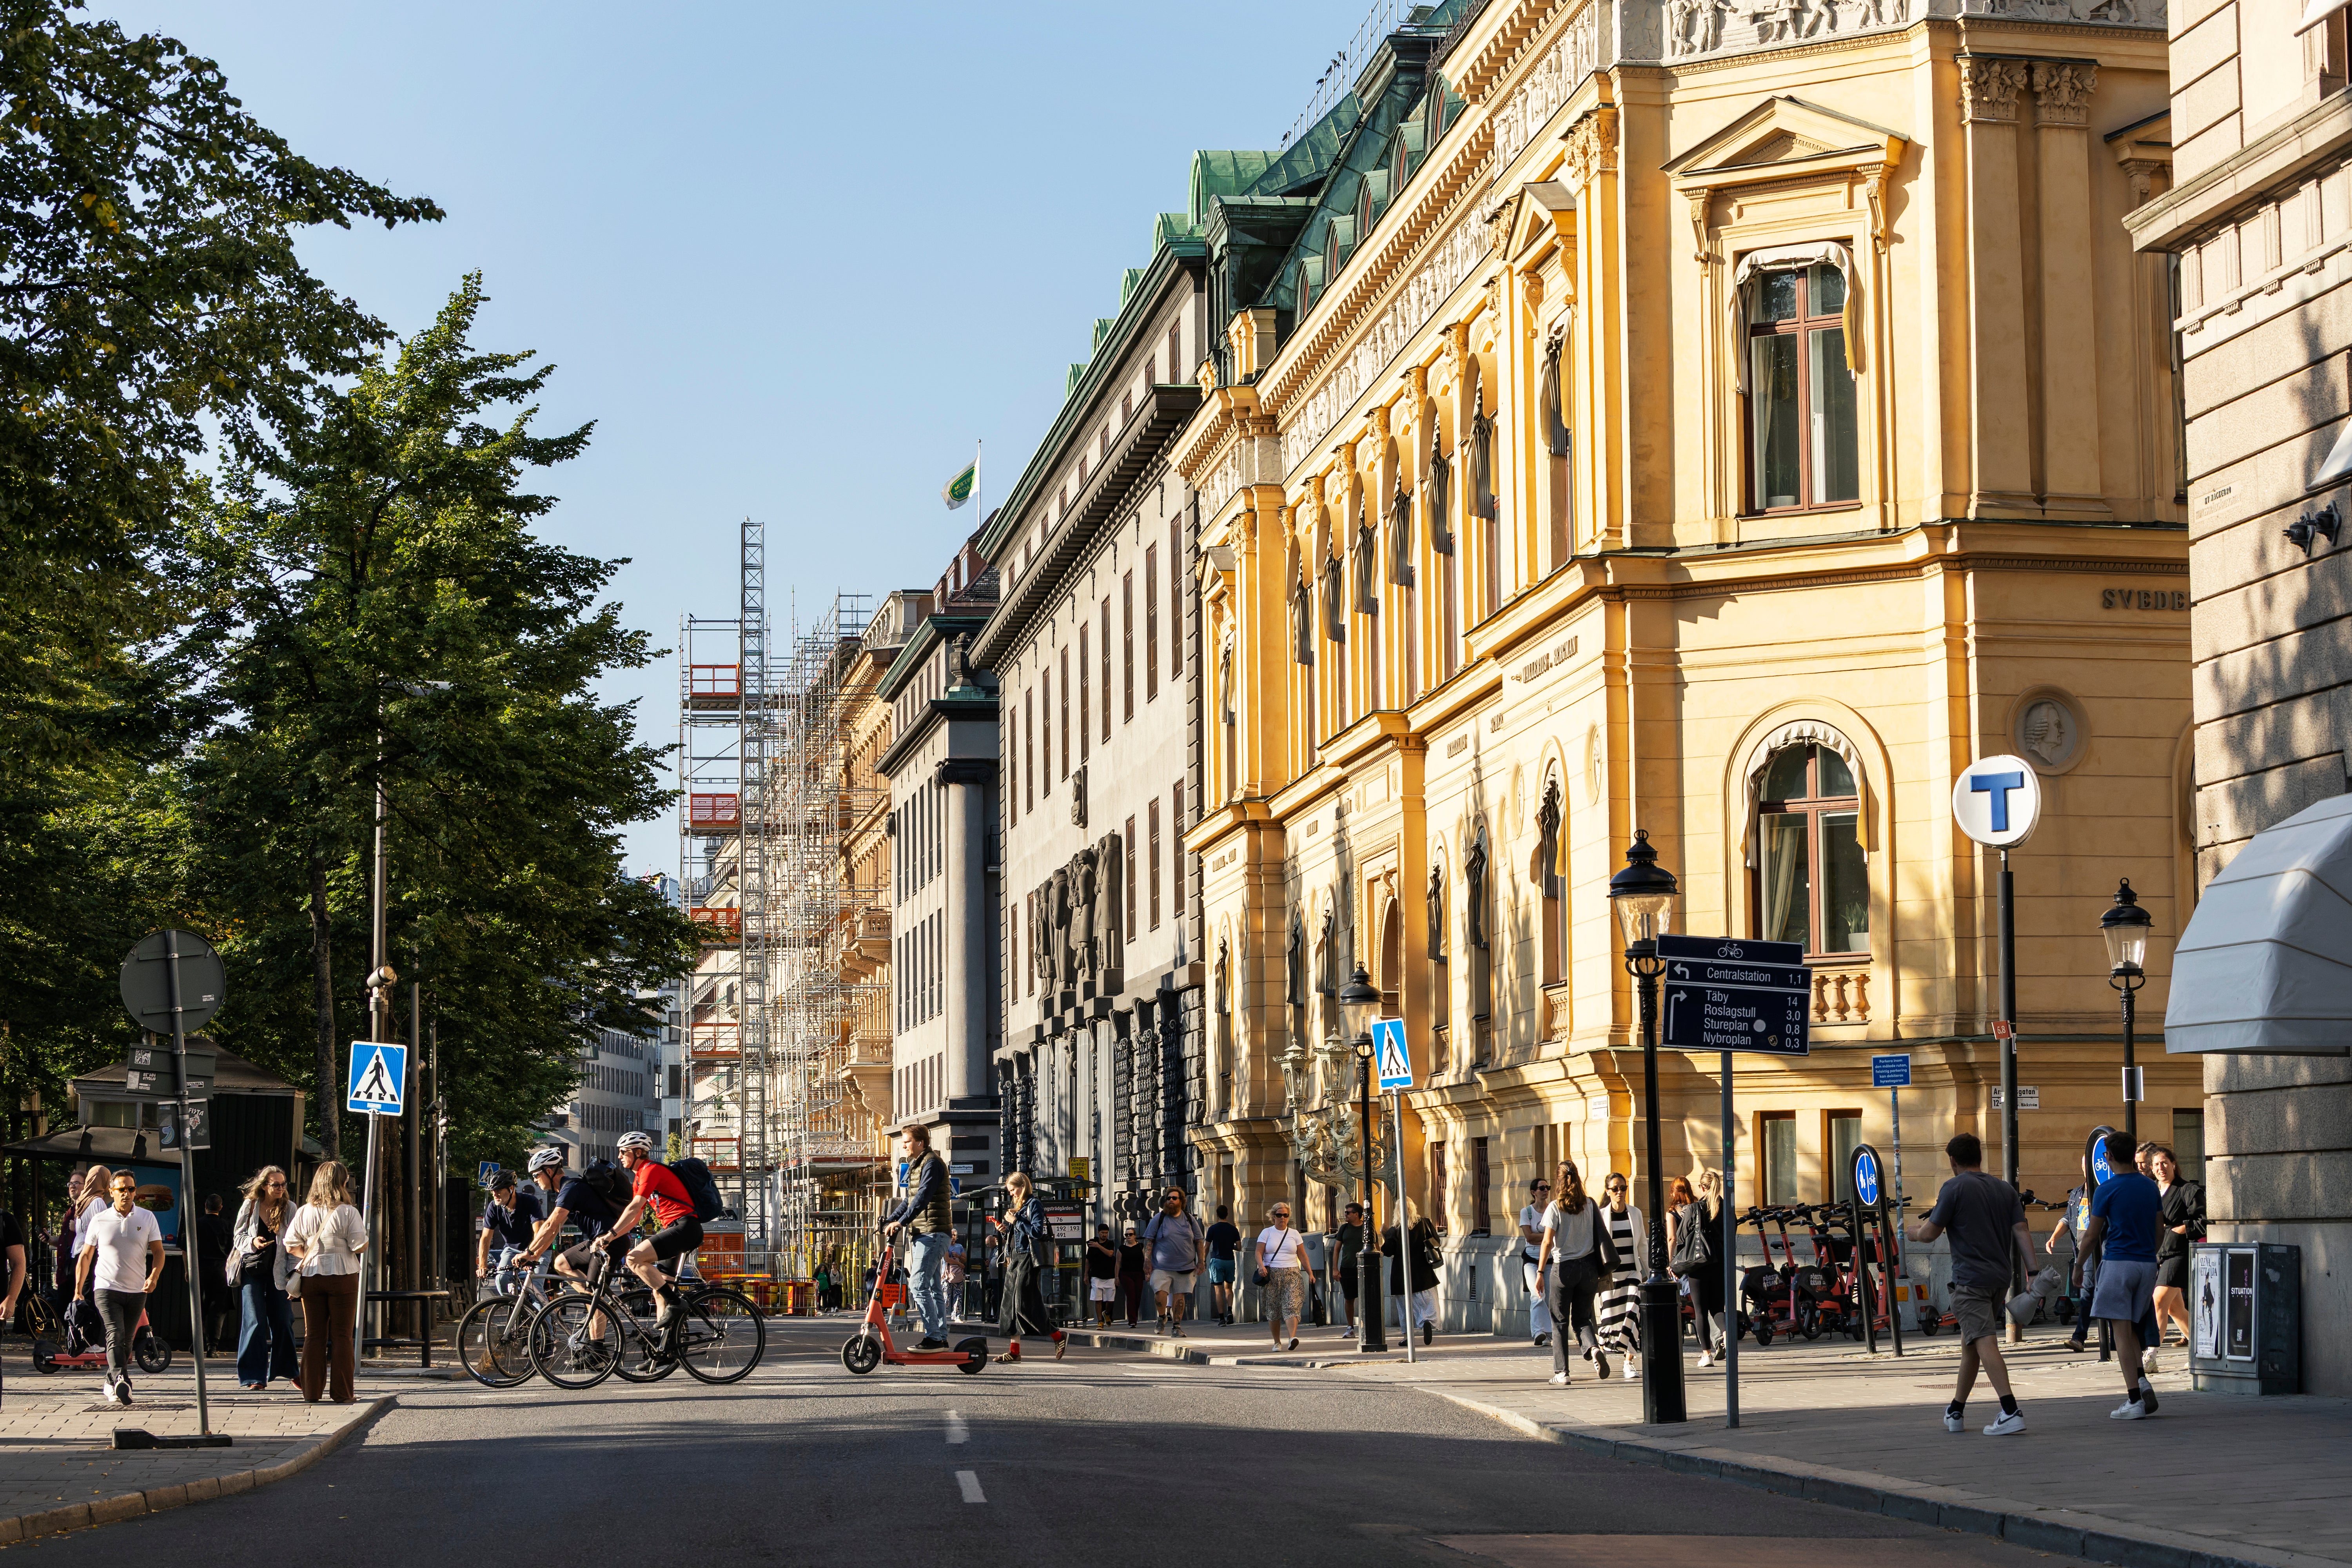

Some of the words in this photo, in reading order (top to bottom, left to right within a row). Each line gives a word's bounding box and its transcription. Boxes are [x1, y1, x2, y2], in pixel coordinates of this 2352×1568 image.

[2103, 589, 2191, 610] SVEDE
[1554, 635, 1578, 666] BERGMAN
[1970, 771, 2024, 832] T
[1707, 967, 1770, 982] Centralstation
[1789, 974, 1801, 985] 1,1
[1706, 990, 1729, 1004] Täby
[1787, 996, 1797, 1006] 14
[1705, 1004, 1755, 1018] Roslagstull
[1786, 1010, 1800, 1022] 3,0
[1704, 1018, 1748, 1032] Stureplan
[1786, 1024, 1800, 1035] 0,8
[1997, 1025, 2006, 1034] 6,8
[1704, 1032, 1751, 1046] Nybroplan
[1786, 1038, 1799, 1049] 0,3
